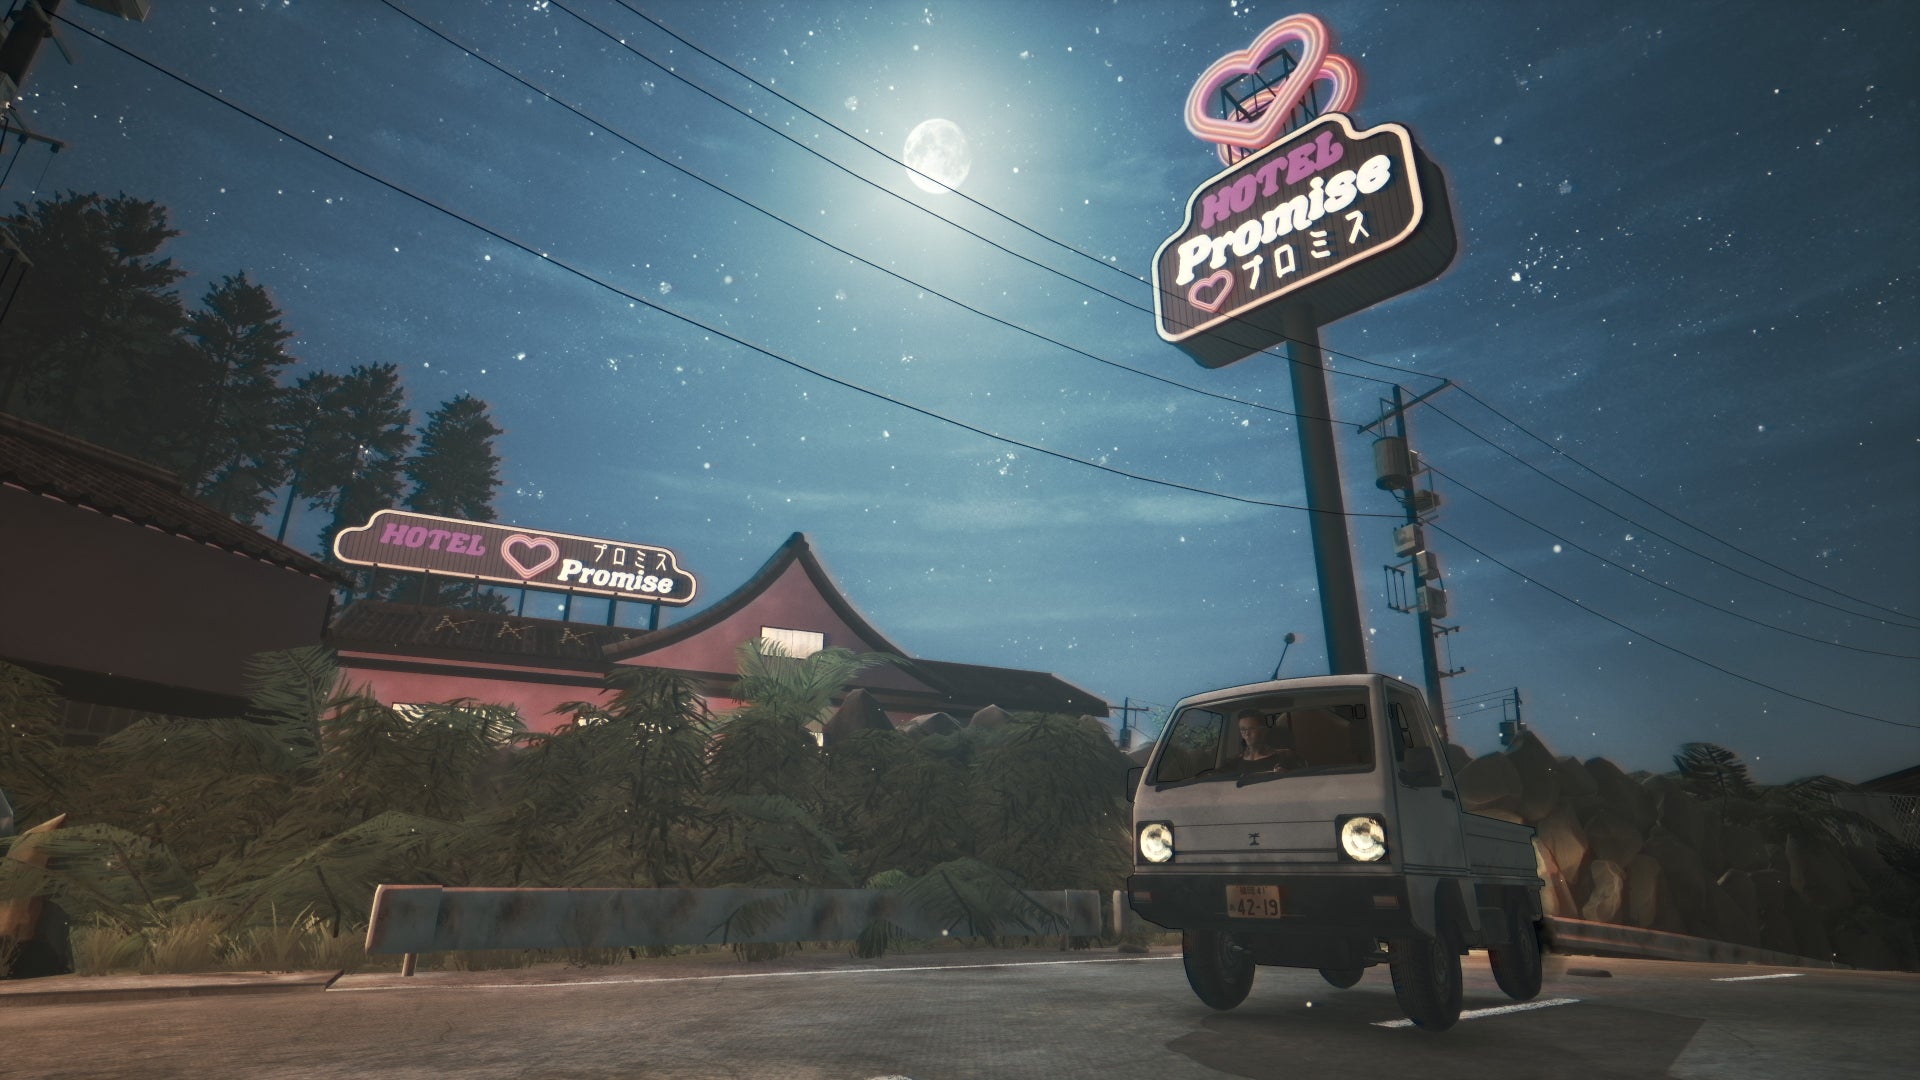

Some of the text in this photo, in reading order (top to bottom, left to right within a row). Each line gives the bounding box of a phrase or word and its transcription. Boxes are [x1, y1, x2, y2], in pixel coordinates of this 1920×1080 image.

[1201, 131, 1343, 229] HOTEL
[1176, 155, 1391, 285] Promise
[1242, 211, 1369, 289] プロミス
[380, 524, 485, 556] HOTEL
[594, 544, 667, 571] プロミス
[557, 560, 672, 593] Promise
[1238, 899, 1278, 915] 42-19
